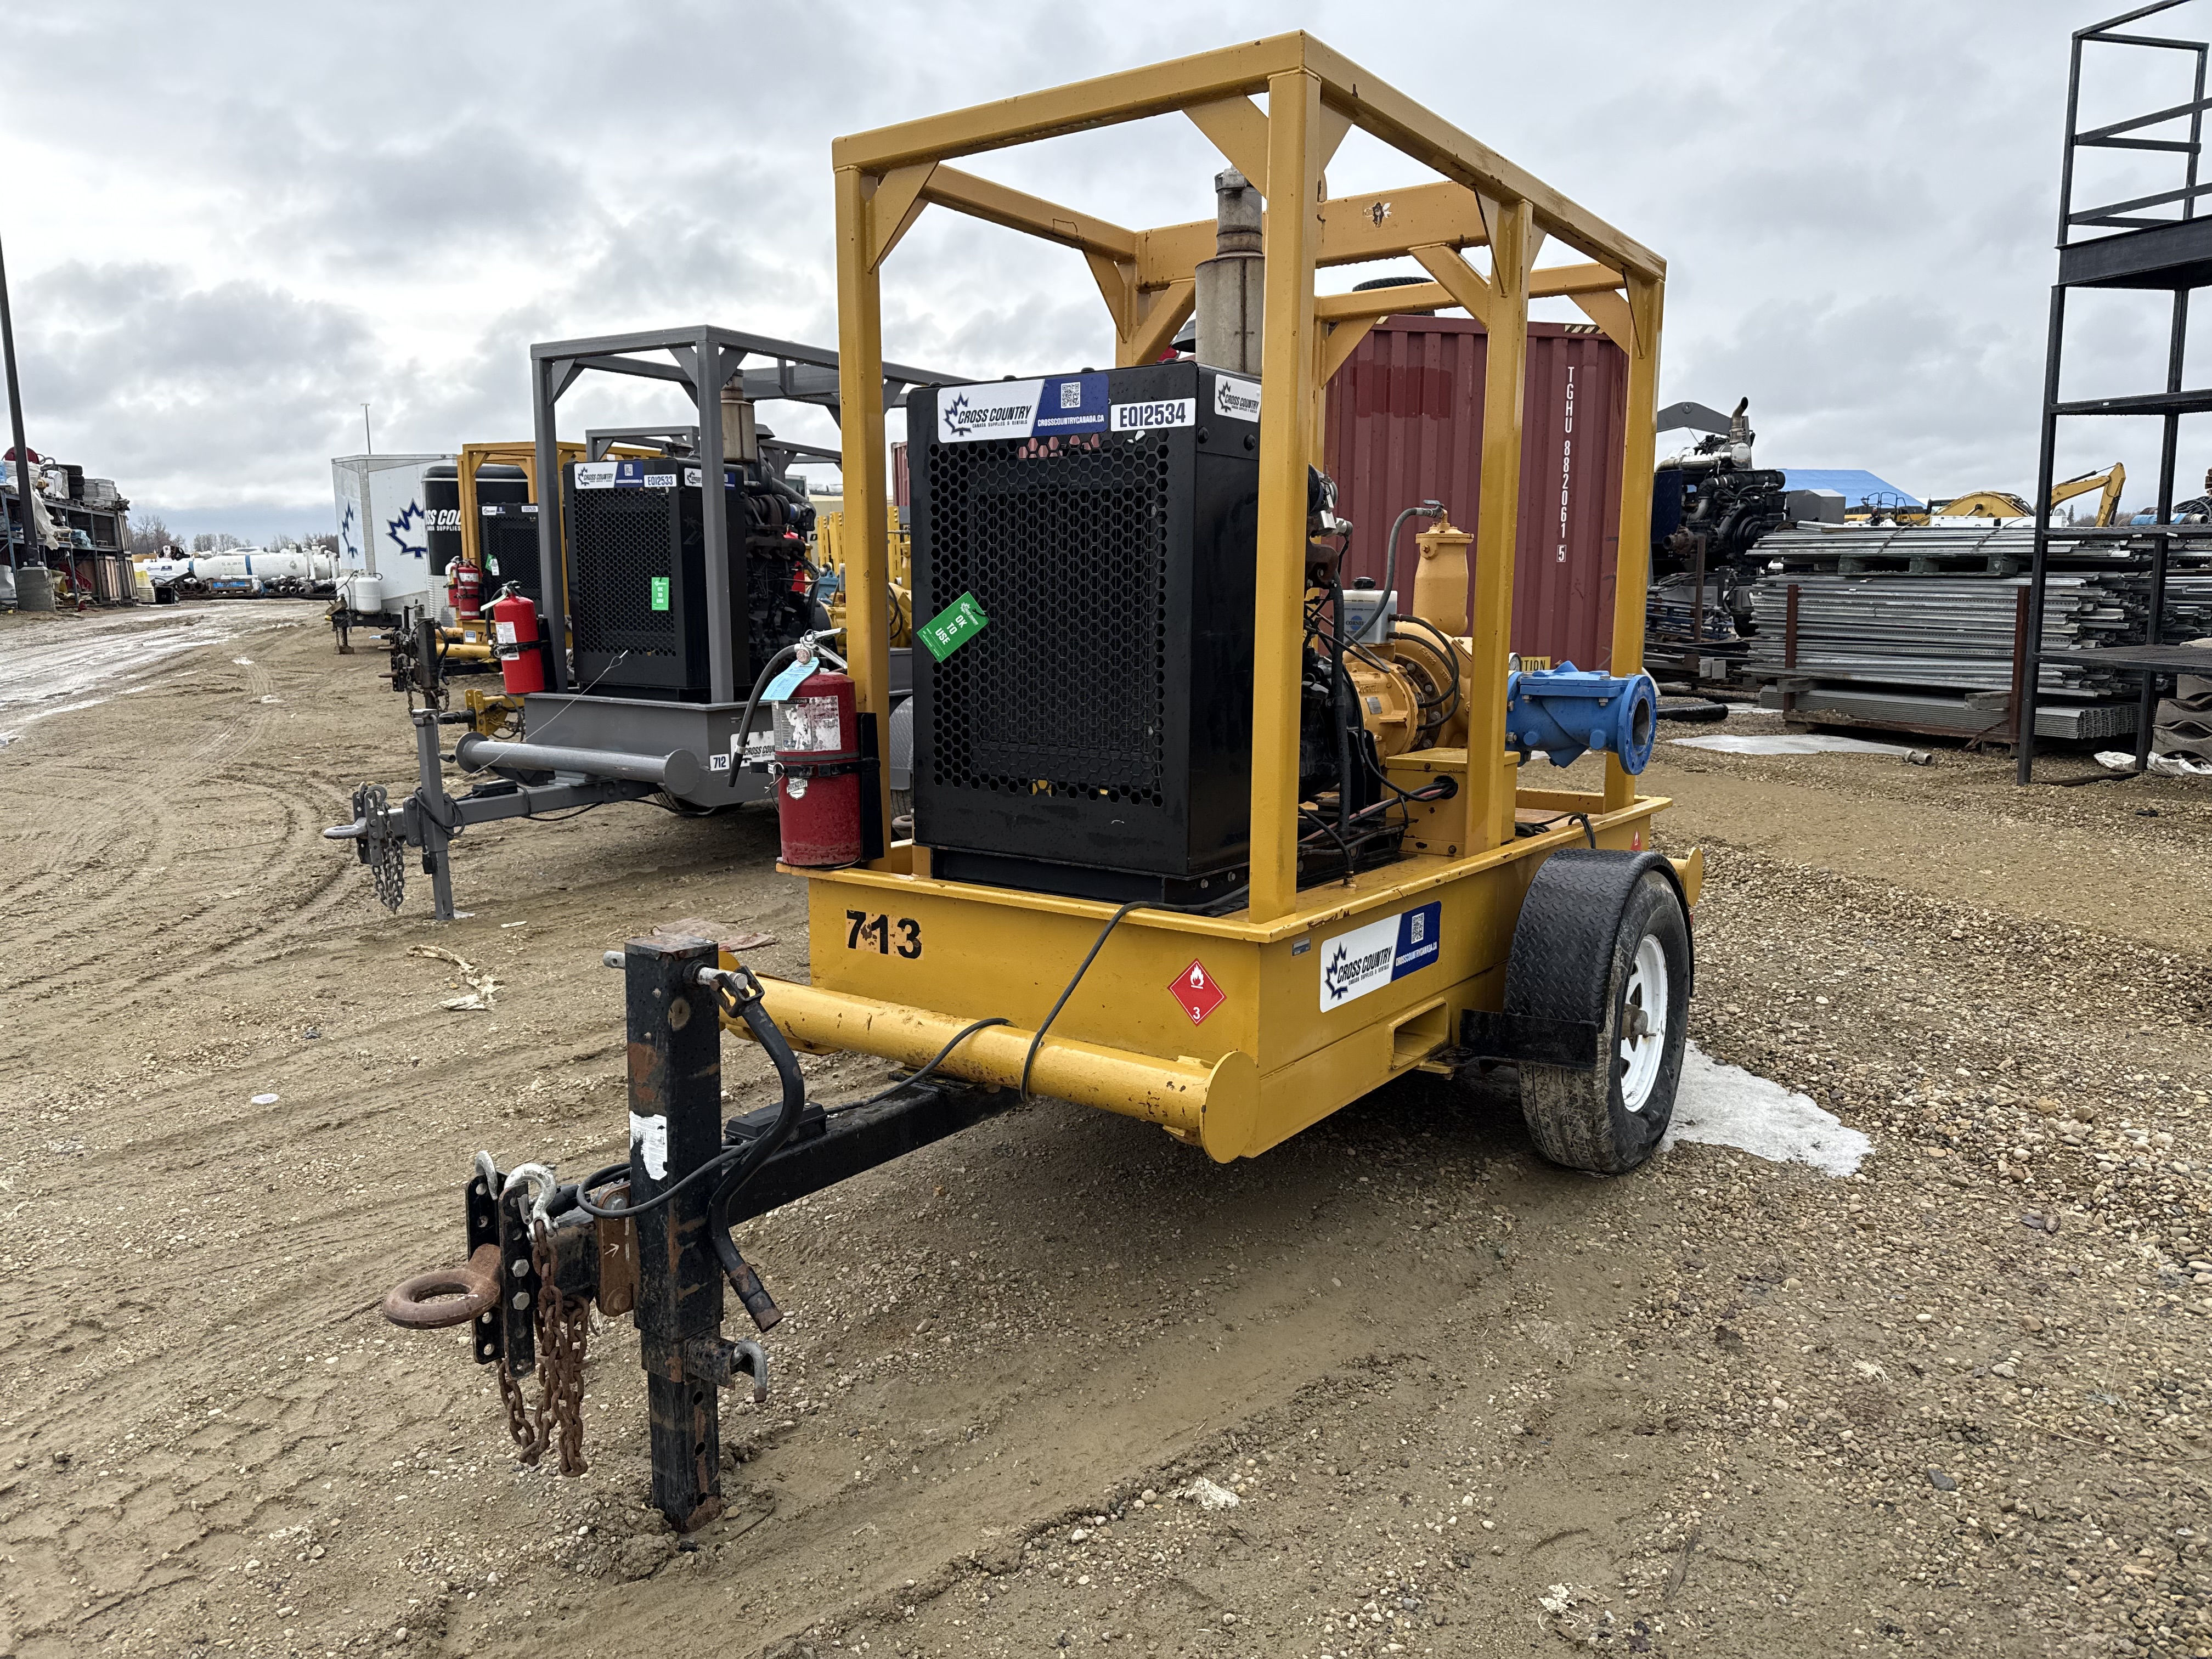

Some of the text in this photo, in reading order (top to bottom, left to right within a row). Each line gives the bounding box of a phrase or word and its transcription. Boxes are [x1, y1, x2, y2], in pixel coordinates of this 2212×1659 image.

[1225, 394, 1240, 405] CROSS
[1240, 398, 1259, 410] COUNTRY
[958, 405, 1032, 424] CROSS COUNTRY
[1037, 415, 1104, 427] CROSSCOUNTRYCANADA.CA
[1120, 402, 1186, 427] EQ12534
[1558, 366, 1575, 562] TGHU 882061 5
[648, 476, 673, 486] EQ12533
[946, 622, 957, 635] TO
[955, 615, 967, 628] OK
[935, 628, 950, 645] USE
[744, 746, 761, 755] CROSS
[713, 756, 726, 768] 712
[847, 910, 922, 959] 713
[1337, 946, 1393, 984] CROSS COUNTRY
[1193, 1006, 1200, 1019] 3
